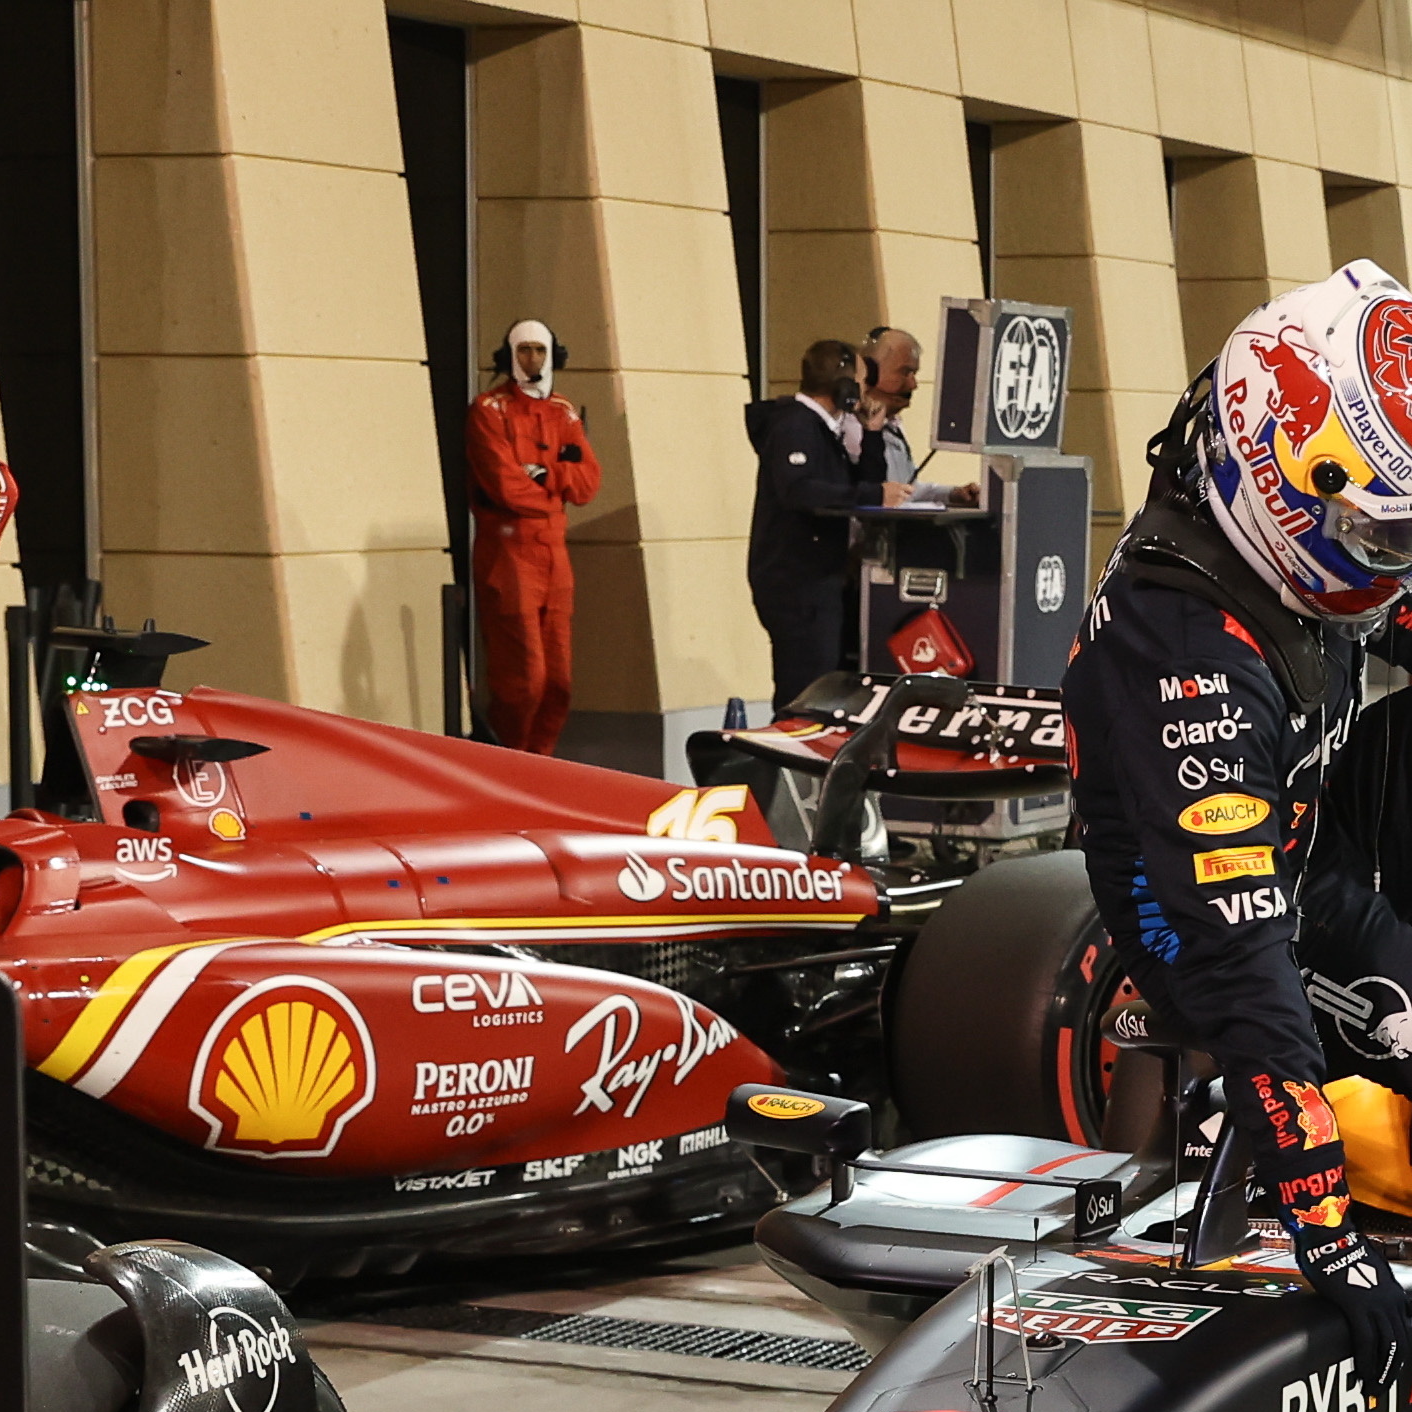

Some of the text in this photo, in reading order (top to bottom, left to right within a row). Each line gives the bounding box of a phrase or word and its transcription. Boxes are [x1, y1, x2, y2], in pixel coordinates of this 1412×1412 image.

[1347, 398, 1392, 465] Player
[1381, 505, 1407, 513] Mobil
[1159, 673, 1230, 702] Mobil
[99, 696, 175, 727] ZCG
[1162, 712, 1243, 750] Claro
[1210, 757, 1244, 783] Sui
[646, 784, 748, 844] 16
[1204, 804, 1257, 825] RAUCH
[116, 837, 172, 862] aws
[1203, 850, 1266, 876] PIRELLI
[667, 857, 843, 901] Santander
[1208, 887, 1287, 924] VISA
[473, 1011, 544, 1028] LOGISTICS
[413, 1056, 534, 1100] PERONI
[411, 1092, 529, 1116] NASTRO AZZURRO
[1251, 1073, 1299, 1150] Red Bull
[618, 1139, 663, 1169] NGK
[394, 1169, 496, 1192] VISTAJET
[523, 1155, 585, 1182] SKF
[1097, 1193, 1114, 1218] Sui
[1026, 1294, 1195, 1320] TAG
[992, 1309, 1186, 1337] HEUER
[178, 1315, 297, 1398] Hard Rock
